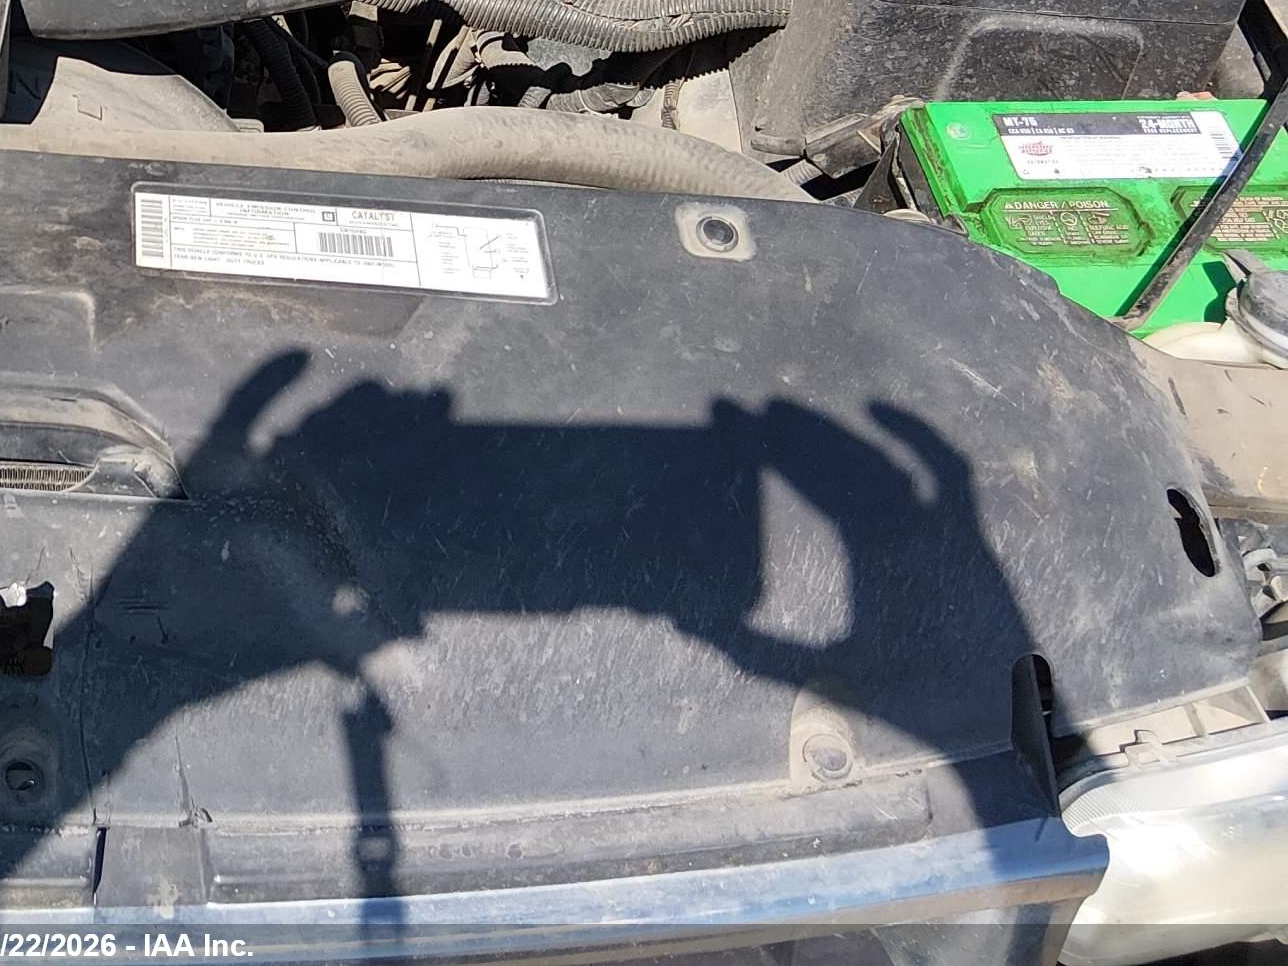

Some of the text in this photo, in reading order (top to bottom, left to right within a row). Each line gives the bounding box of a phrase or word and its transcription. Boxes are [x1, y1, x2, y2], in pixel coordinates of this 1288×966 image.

[1013, 201, 1058, 210] DANGER
[1067, 200, 1109, 209] POISON
[351, 210, 396, 222] CATALYST
